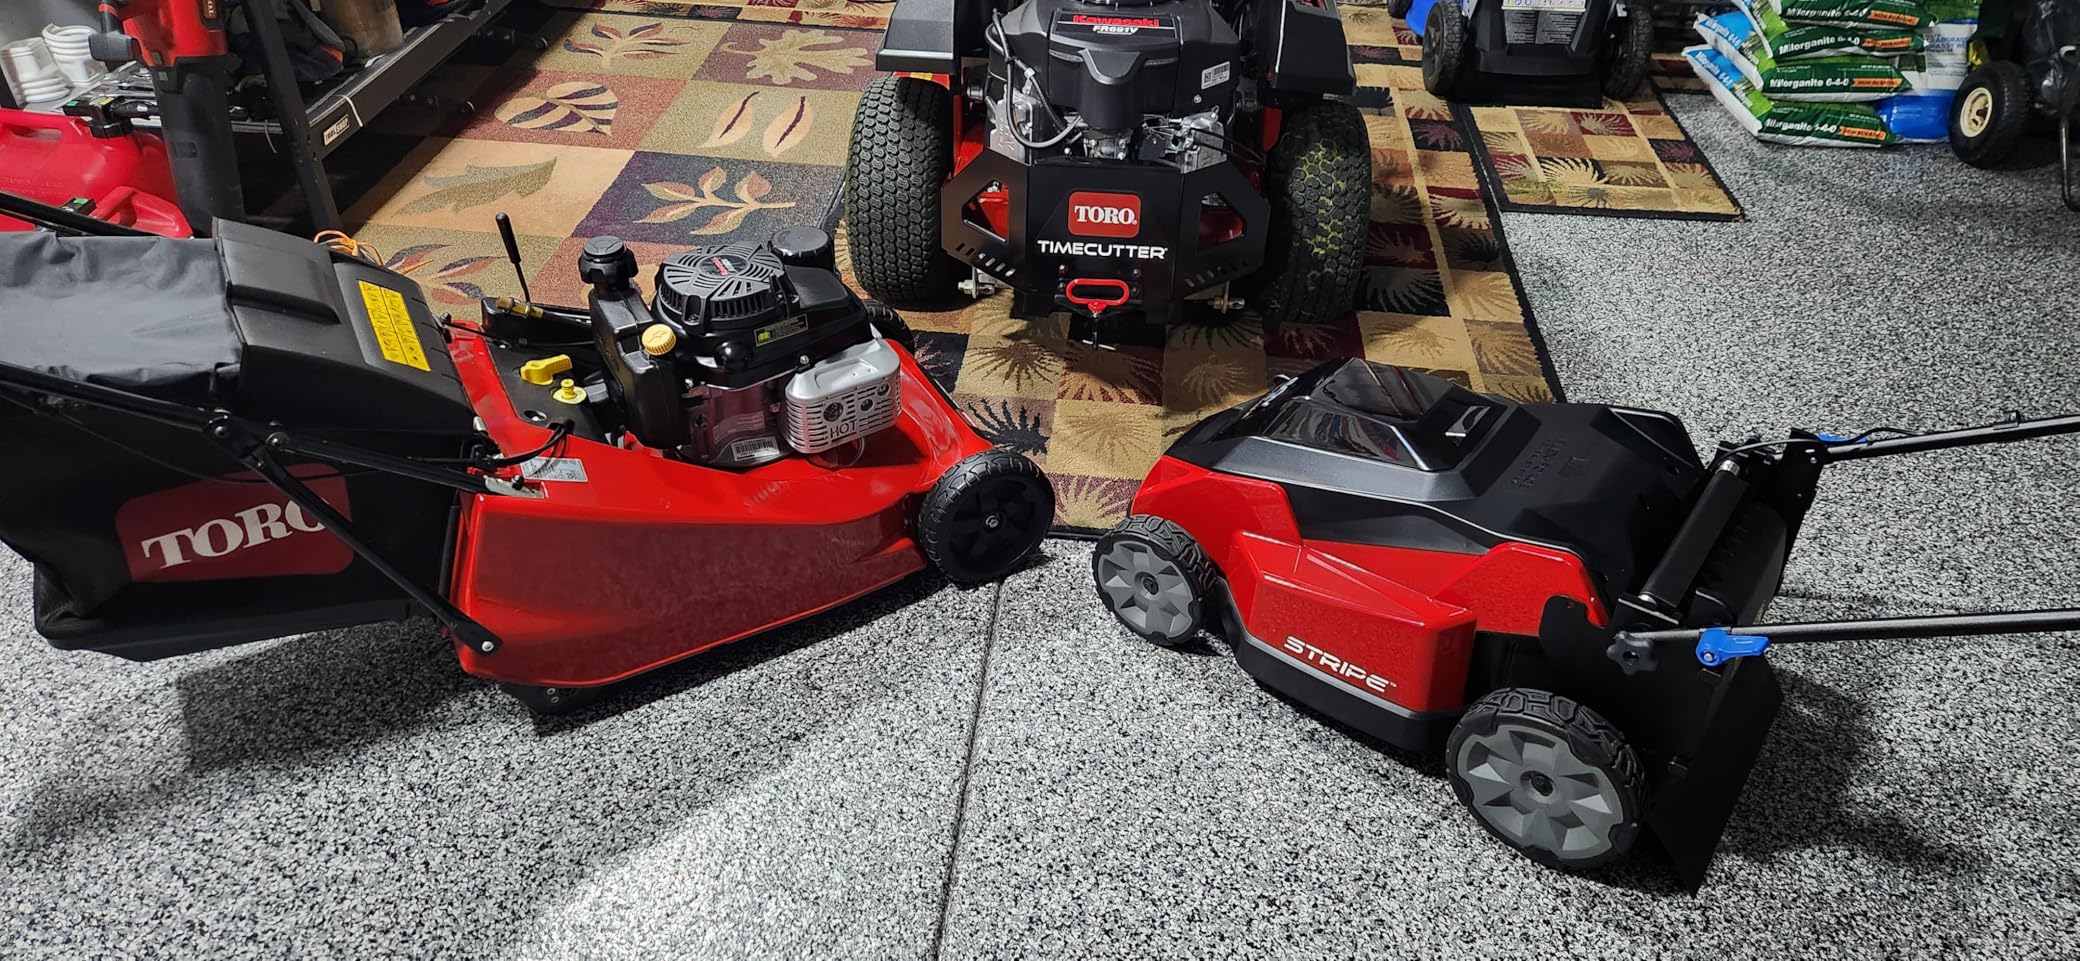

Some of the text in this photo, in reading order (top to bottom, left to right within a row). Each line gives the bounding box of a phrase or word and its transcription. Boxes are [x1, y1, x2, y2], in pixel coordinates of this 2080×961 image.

[1073, 15, 1160, 28] Kawasaki
[1779, 36, 1836, 55] Milorganite
[1769, 77, 1823, 89] Milorganite
[1074, 205, 1136, 225] TORO
[1037, 240, 1167, 260] TIMECUTTER
[830, 419, 858, 439] HOT
[1284, 635, 1390, 693] STRIPE
